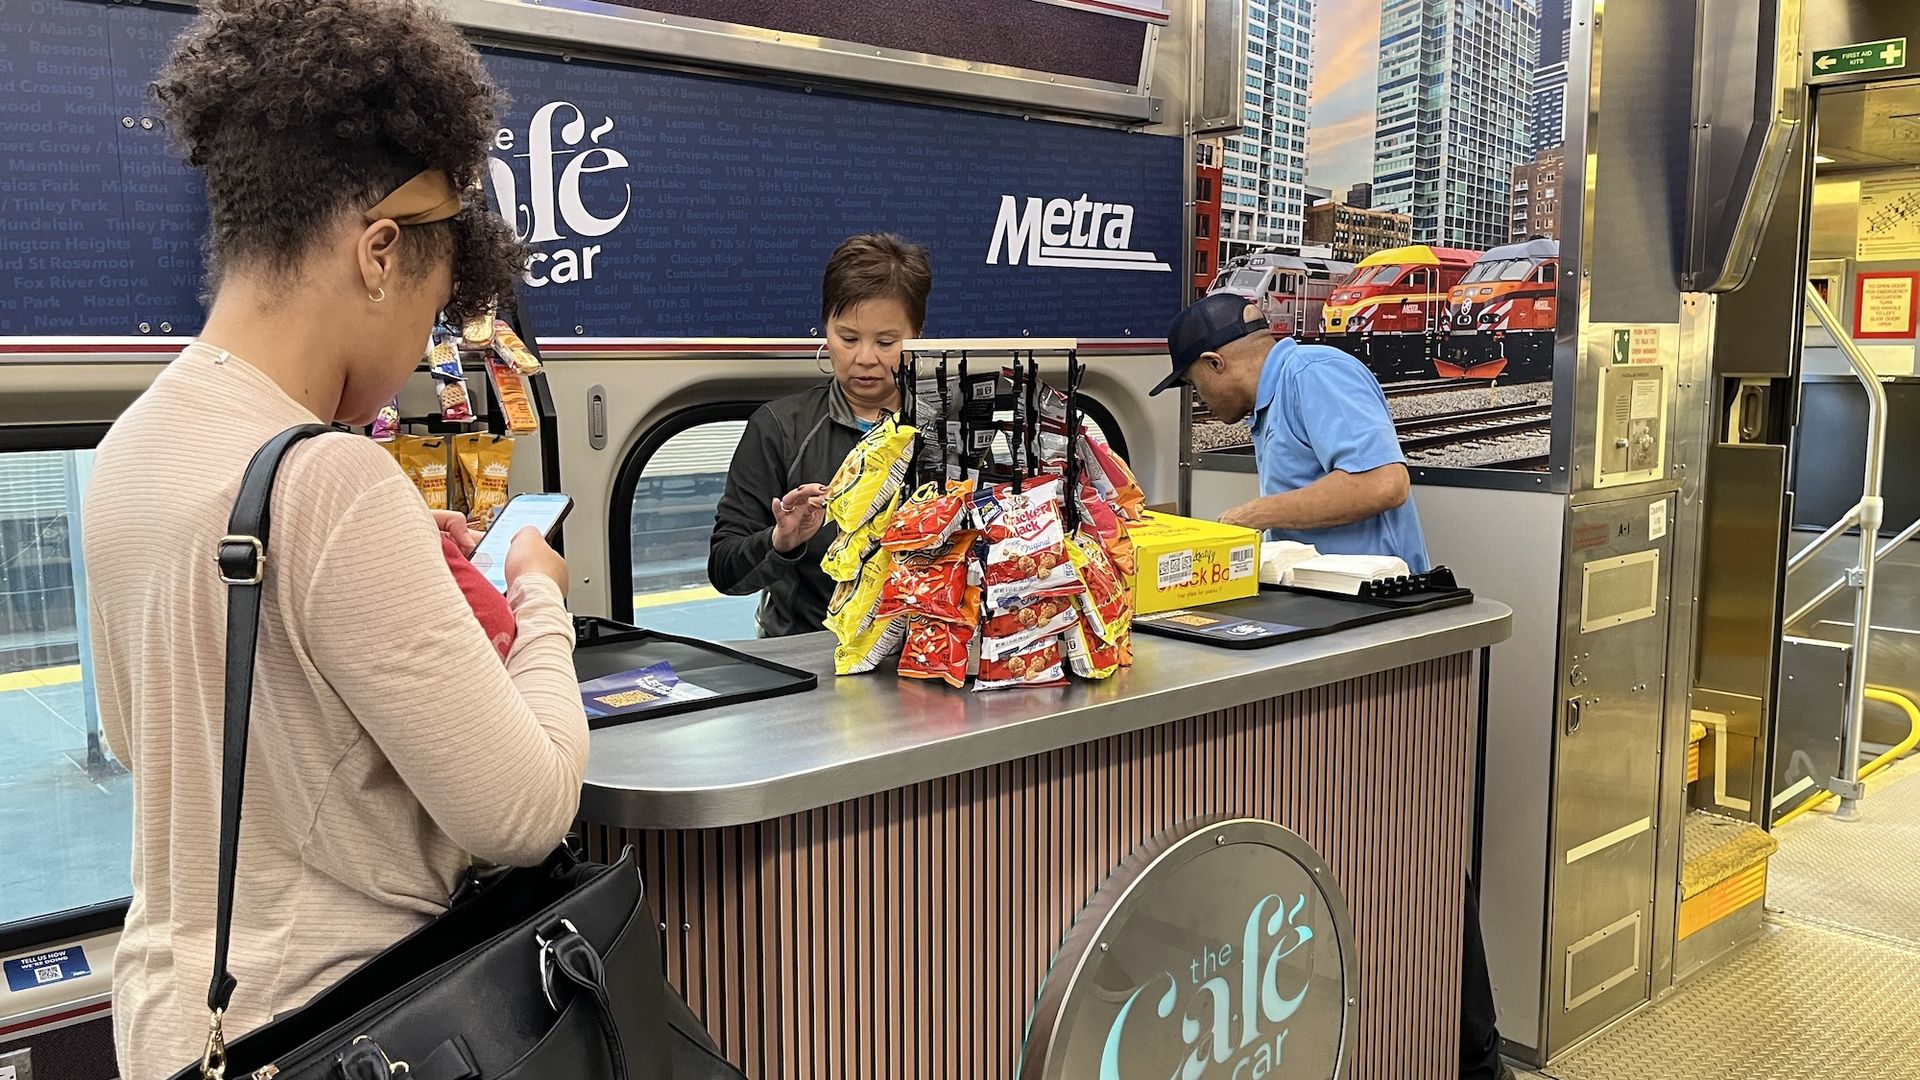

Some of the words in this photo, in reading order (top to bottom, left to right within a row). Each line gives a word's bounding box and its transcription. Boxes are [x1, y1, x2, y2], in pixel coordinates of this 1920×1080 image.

[40, 23, 83, 36] Main
[87, 24, 105, 38] St
[1842, 52, 1860, 60] FIRST
[36, 60, 128, 80] Barrington
[20, 80, 95, 100] Crossing
[555, 80, 581, 93] Blue
[584, 82, 619, 95] Island
[632, 84, 658, 97] 99th
[660, 86, 672, 98] St
[607, 100, 633, 111] Hills
[645, 102, 697, 115] Jefferson
[698, 105, 721, 116] Park
[733, 107, 763, 119] 103rd
[641, 115, 653, 126] St
[666, 119, 705, 130] Lemont
[58, 122, 95, 135] Park
[717, 122, 740, 135] Cary
[752, 123, 771, 134] Fox
[619, 132, 657, 143] Timber
[660, 133, 687, 144] Road
[699, 135, 751, 148] Gladstone
[752, 137, 774, 149] Park
[785, 140, 812, 151] Hazel
[666, 148, 710, 160] Fairview
[712, 151, 751, 161] Avenue
[9, 159, 101, 174] Mannheim
[488, 101, 631, 243] afé
[637, 163, 673, 175] Patriot
[674, 165, 712, 176] Station
[724, 166, 755, 177] 111th
[773, 168, 811, 180] Morgan
[812, 169, 832, 180] Park
[42, 180, 81, 192] Park
[584, 176, 610, 188] Park
[662, 179, 687, 190] Lake
[699, 181, 747, 191] Glenview
[658, 193, 717, 205] Libertyville
[13, 199, 66, 215] Tinley
[71, 200, 108, 213] Park
[631, 208, 663, 220] 103rd
[666, 209, 677, 219] St
[686, 209, 725, 222] Beverly
[727, 210, 749, 221] Hills
[106, 218, 157, 236] Tinley
[160, 219, 197, 234] Park
[682, 225, 738, 238] Hollywood
[986, 193, 1134, 265] Metra
[65, 237, 132, 254] Heights
[635, 239, 673, 249] Edison
[674, 239, 698, 250] Park
[28, 257, 48, 271] St
[50, 256, 137, 271] Rosemoor
[522, 244, 602, 288] car
[633, 254, 657, 265] Park
[669, 253, 712, 266] Chicago
[613, 269, 653, 281] Harvey
[665, 268, 729, 279] Cumberland
[14, 277, 45, 290] Fox
[50, 276, 96, 290] River
[99, 275, 150, 290] Grove
[765, 282, 813, 294] Highlands
[594, 285, 619, 296] Golf
[632, 284, 658, 296] Blue
[660, 283, 692, 295] Island
[699, 283, 743, 294] Vermont
[23, 295, 61, 310] Park
[83, 294, 132, 309] Hazel
[574, 300, 633, 311] Flossmoor
[646, 299, 678, 310] 107th
[680, 299, 691, 309] St
[657, 312, 682, 324] 83rd
[703, 311, 733, 322] South
[734, 310, 775, 323] Chicago
[1002, 504, 1049, 526] Cracker
[1012, 520, 1041, 538] Jack
[21, 957, 37, 965] TELL
[47, 950, 66, 959] HOW
[44, 956, 69, 965] DOING
[1190, 943, 1232, 984] the
[1232, 1028, 1288, 1080] car
